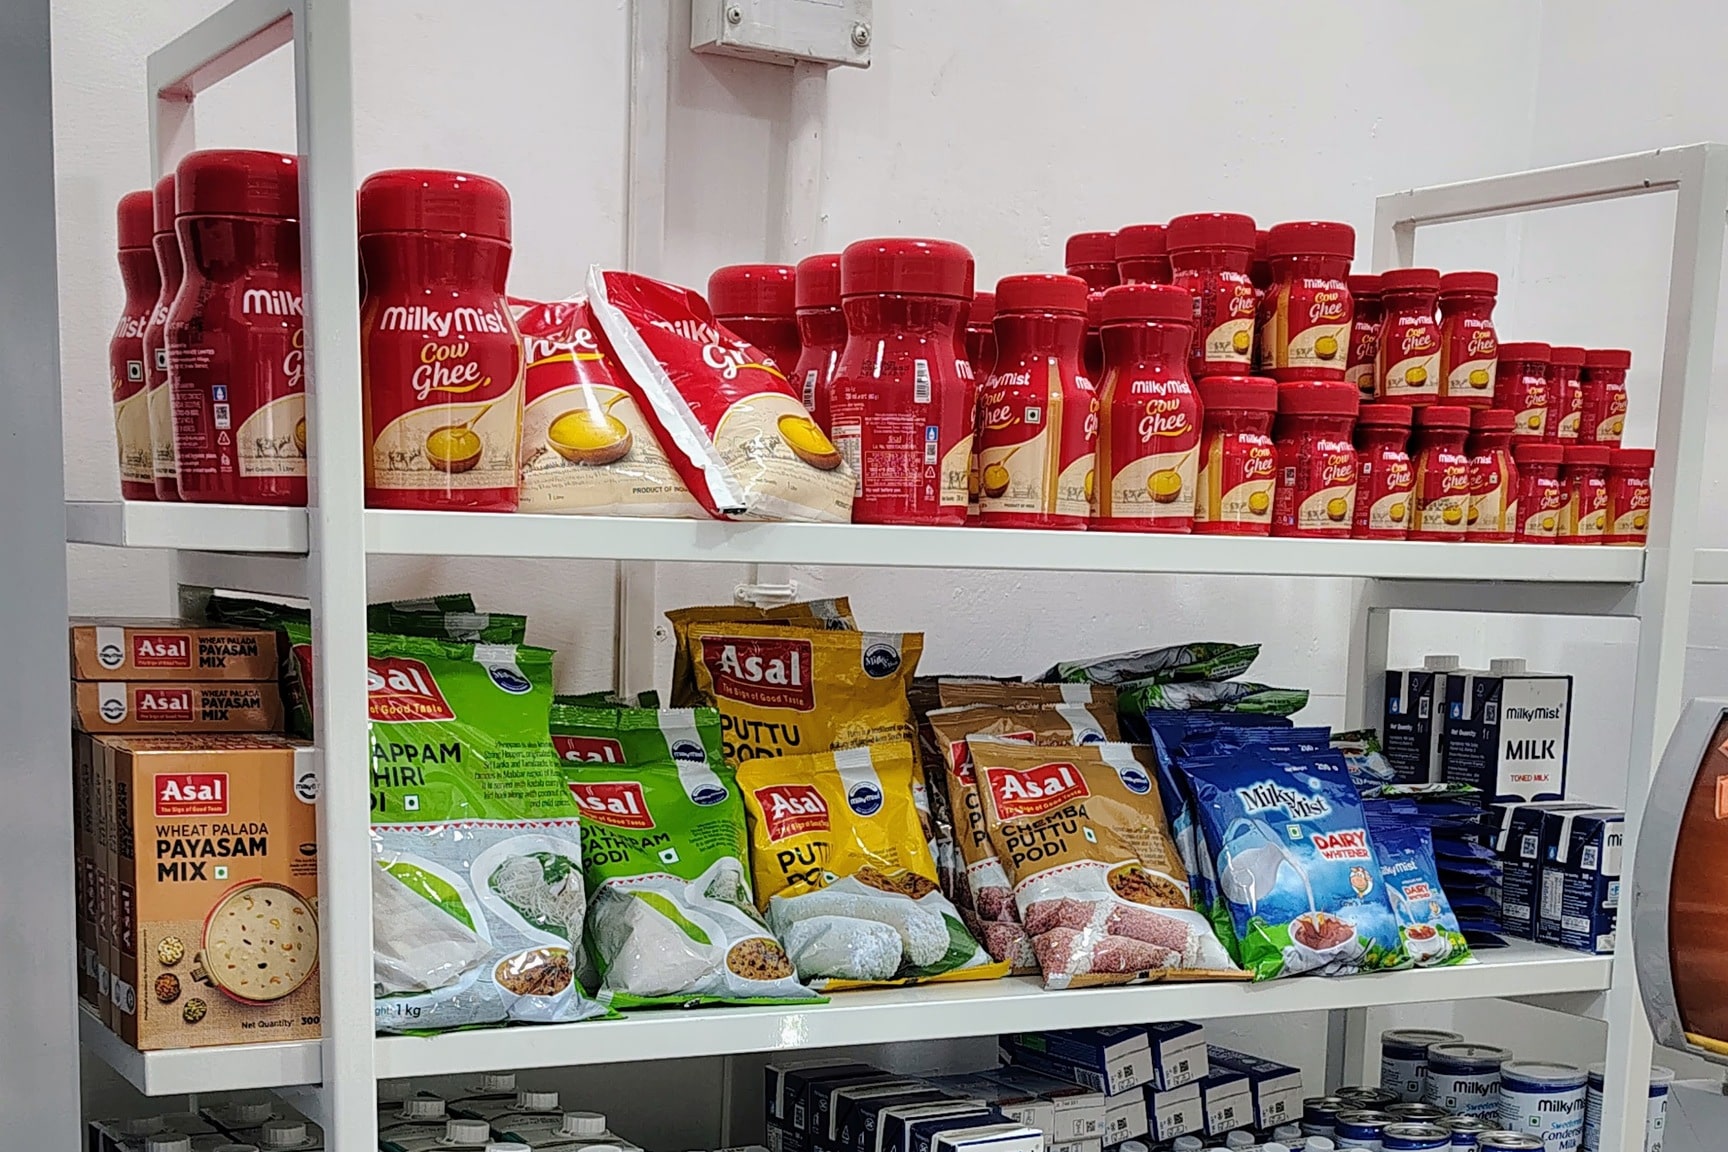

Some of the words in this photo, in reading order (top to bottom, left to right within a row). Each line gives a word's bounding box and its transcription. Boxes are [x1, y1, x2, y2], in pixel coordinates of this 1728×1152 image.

[1315, 292, 1338, 302] Cow
[1310, 302, 1343, 322] Ghee
[421, 339, 470, 365] Cow
[1402, 334, 1431, 354] Ghee
[412, 360, 480, 401] Ghee
[1146, 398, 1180, 417] Cow
[1139, 412, 1185, 443] Ghee
[137, 639, 186, 658] Asal
[199, 644, 258, 656] PAYASAM
[227, 637, 256, 645] PALADA
[199, 656, 226, 668] MIX
[719, 645, 802, 686] Asal
[140, 695, 189, 712] Asal
[200, 689, 227, 697] WHEAT
[230, 689, 260, 698] PALADA
[201, 697, 261, 709] PAYASAM
[202, 709, 229, 721] MIX
[380, 705, 410, 715] Good
[415, 704, 442, 713] Taste
[721, 713, 800, 746] PUTTU
[1505, 739, 1556, 760] MILK
[1001, 768, 1076, 800] Asal
[1510, 774, 1532, 782] TONED
[1533, 773, 1550, 781] MILK
[161, 778, 222, 803] Asal
[1240, 782, 1299, 812] Milky
[771, 791, 826, 820] Asal
[1289, 796, 1329, 820] Mist
[156, 824, 208, 837] WHEAT
[212, 823, 268, 836] PALADA
[1002, 805, 1089, 837] CHEMBA
[1006, 822, 1078, 852] PUTTU
[1313, 831, 1365, 850] DAIRY
[157, 837, 268, 858] PAYASAM
[1013, 840, 1067, 869] PODI
[1323, 850, 1369, 859] WHITENER
[158, 861, 208, 882] MIX
[396, 1005, 401, 1016] 1
[403, 1004, 421, 1018] kg
[241, 1021, 255, 1030] Net
[257, 1018, 293, 1030] Quantity
